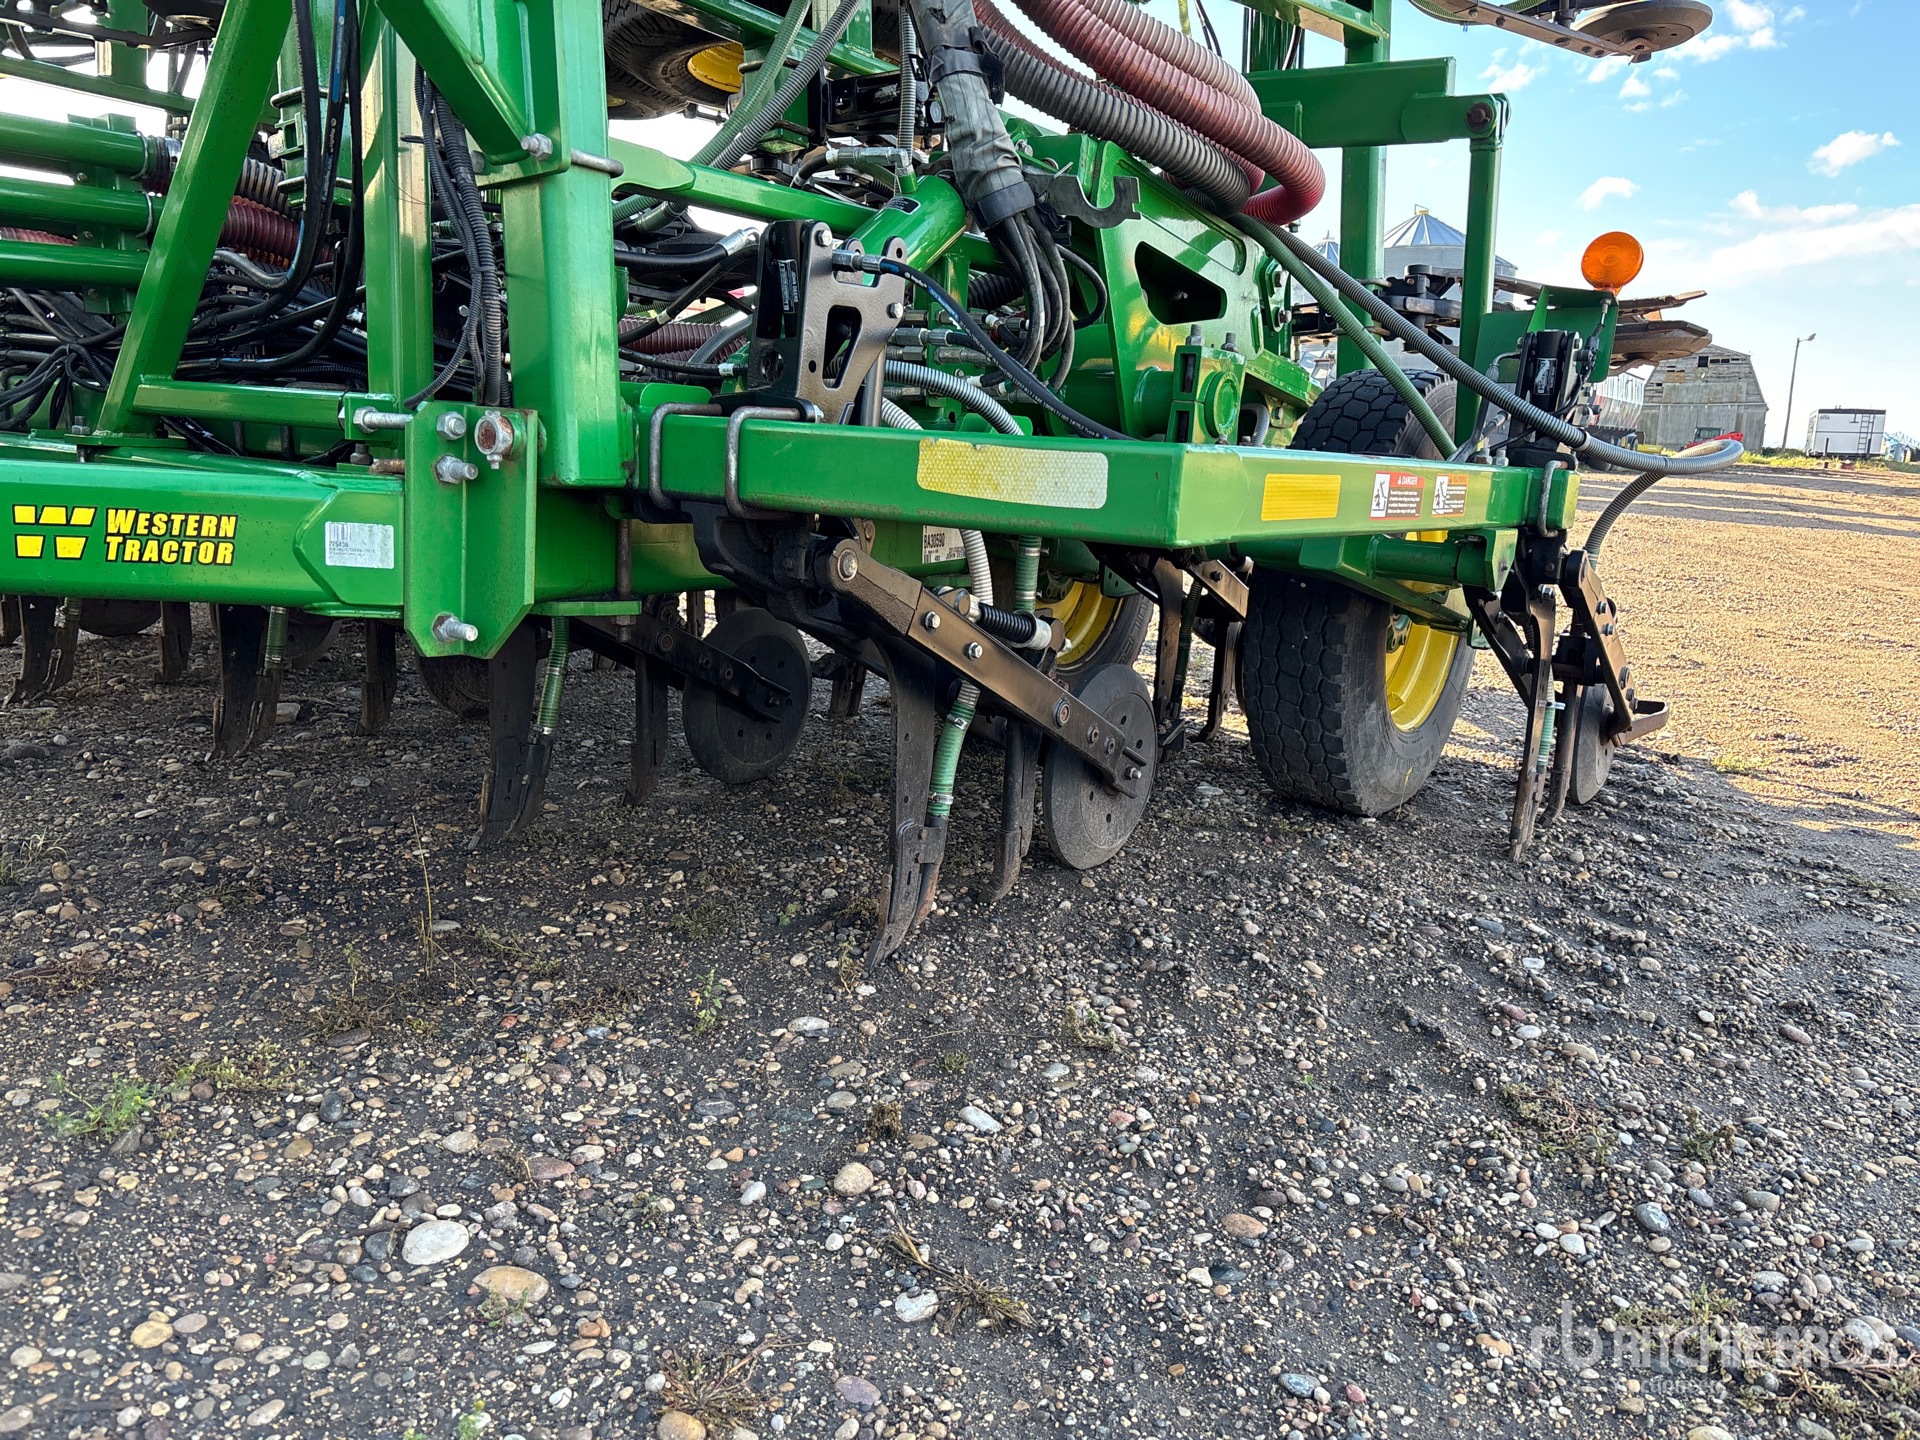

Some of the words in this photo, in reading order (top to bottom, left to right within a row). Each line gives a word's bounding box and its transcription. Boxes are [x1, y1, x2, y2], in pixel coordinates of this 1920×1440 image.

[1401, 476, 1419, 485] DANGER
[106, 507, 238, 539] WESTERN
[105, 535, 235, 565] TRACTOR
